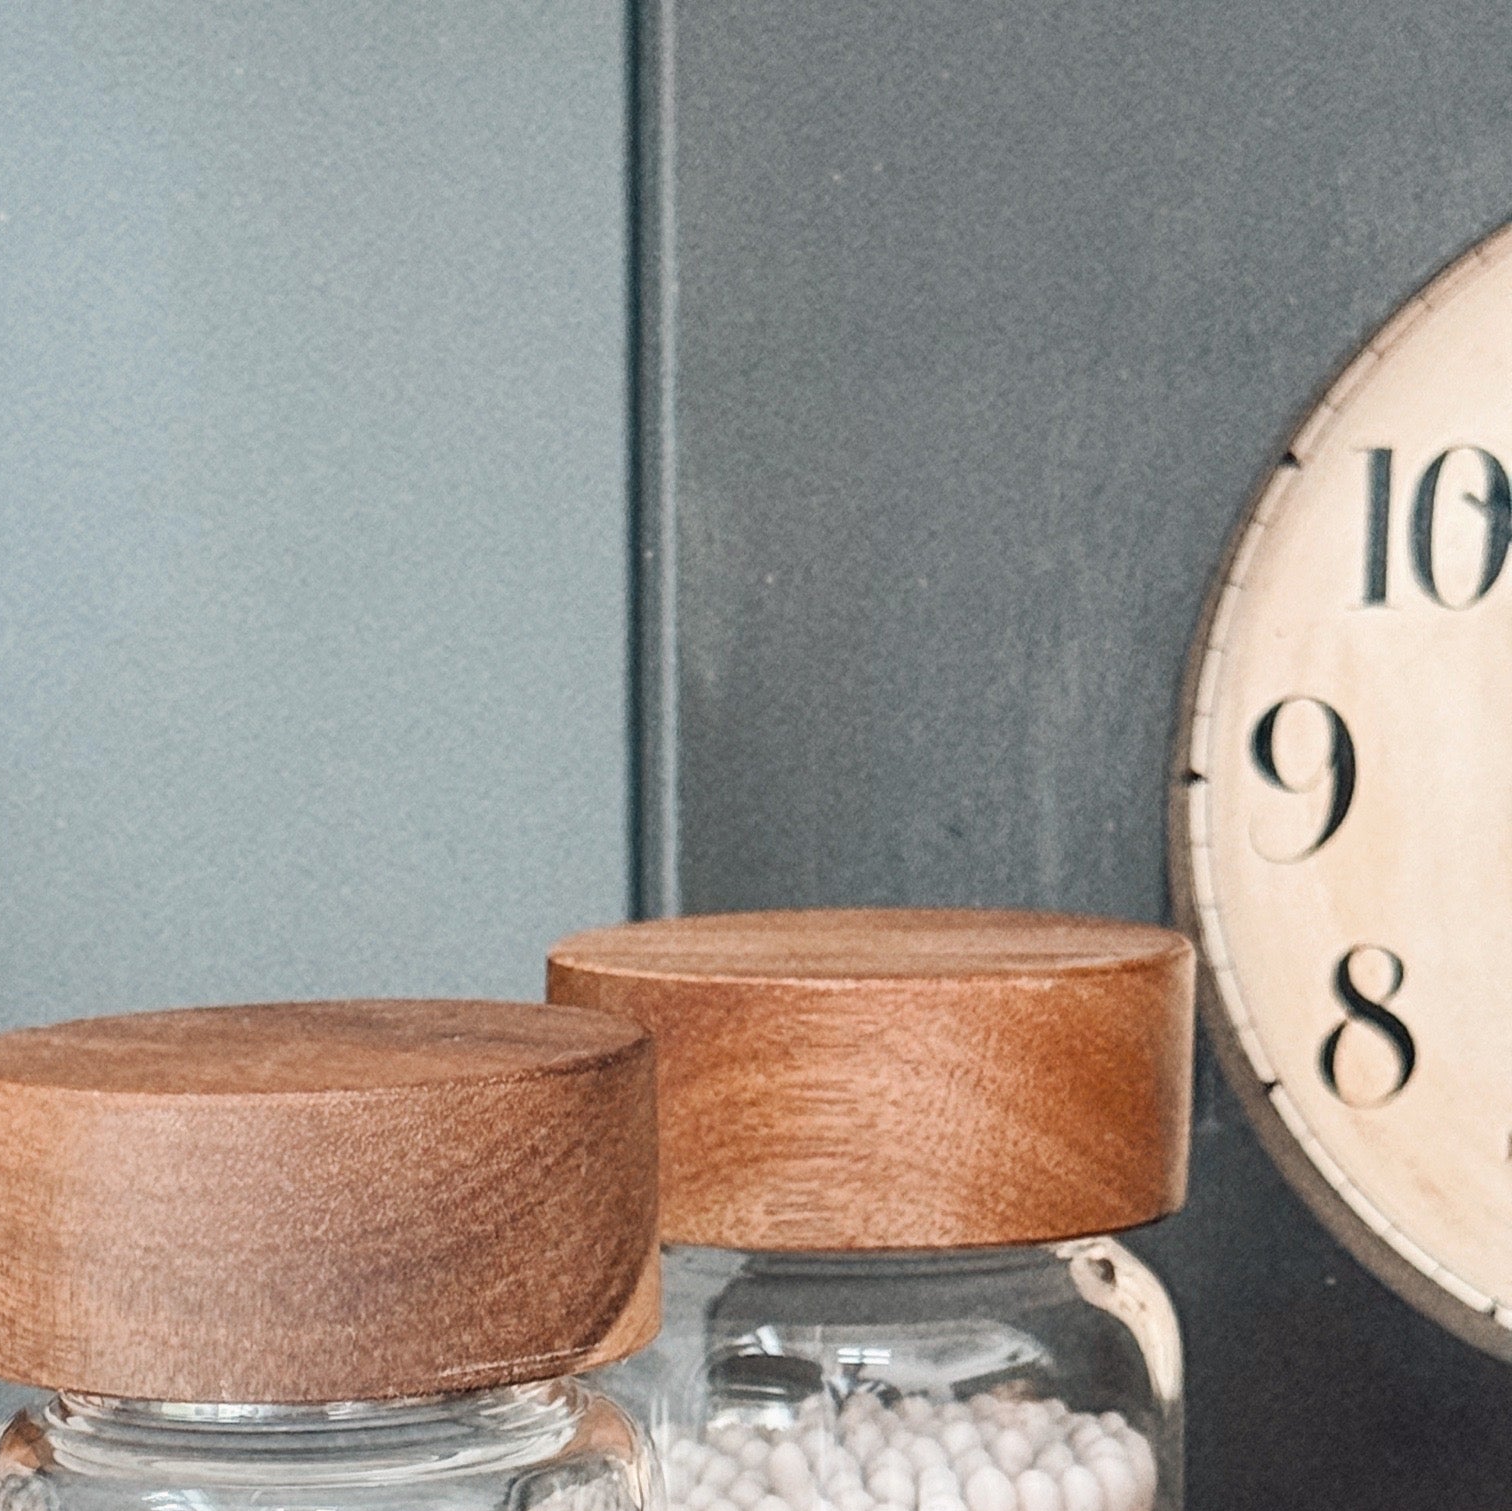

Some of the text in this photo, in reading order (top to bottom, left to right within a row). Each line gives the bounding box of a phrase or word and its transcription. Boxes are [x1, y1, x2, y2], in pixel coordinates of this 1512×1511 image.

[1346, 444, 1512, 610] 10
[1248, 694, 1357, 866] 9
[1317, 942, 1417, 1110] 8
